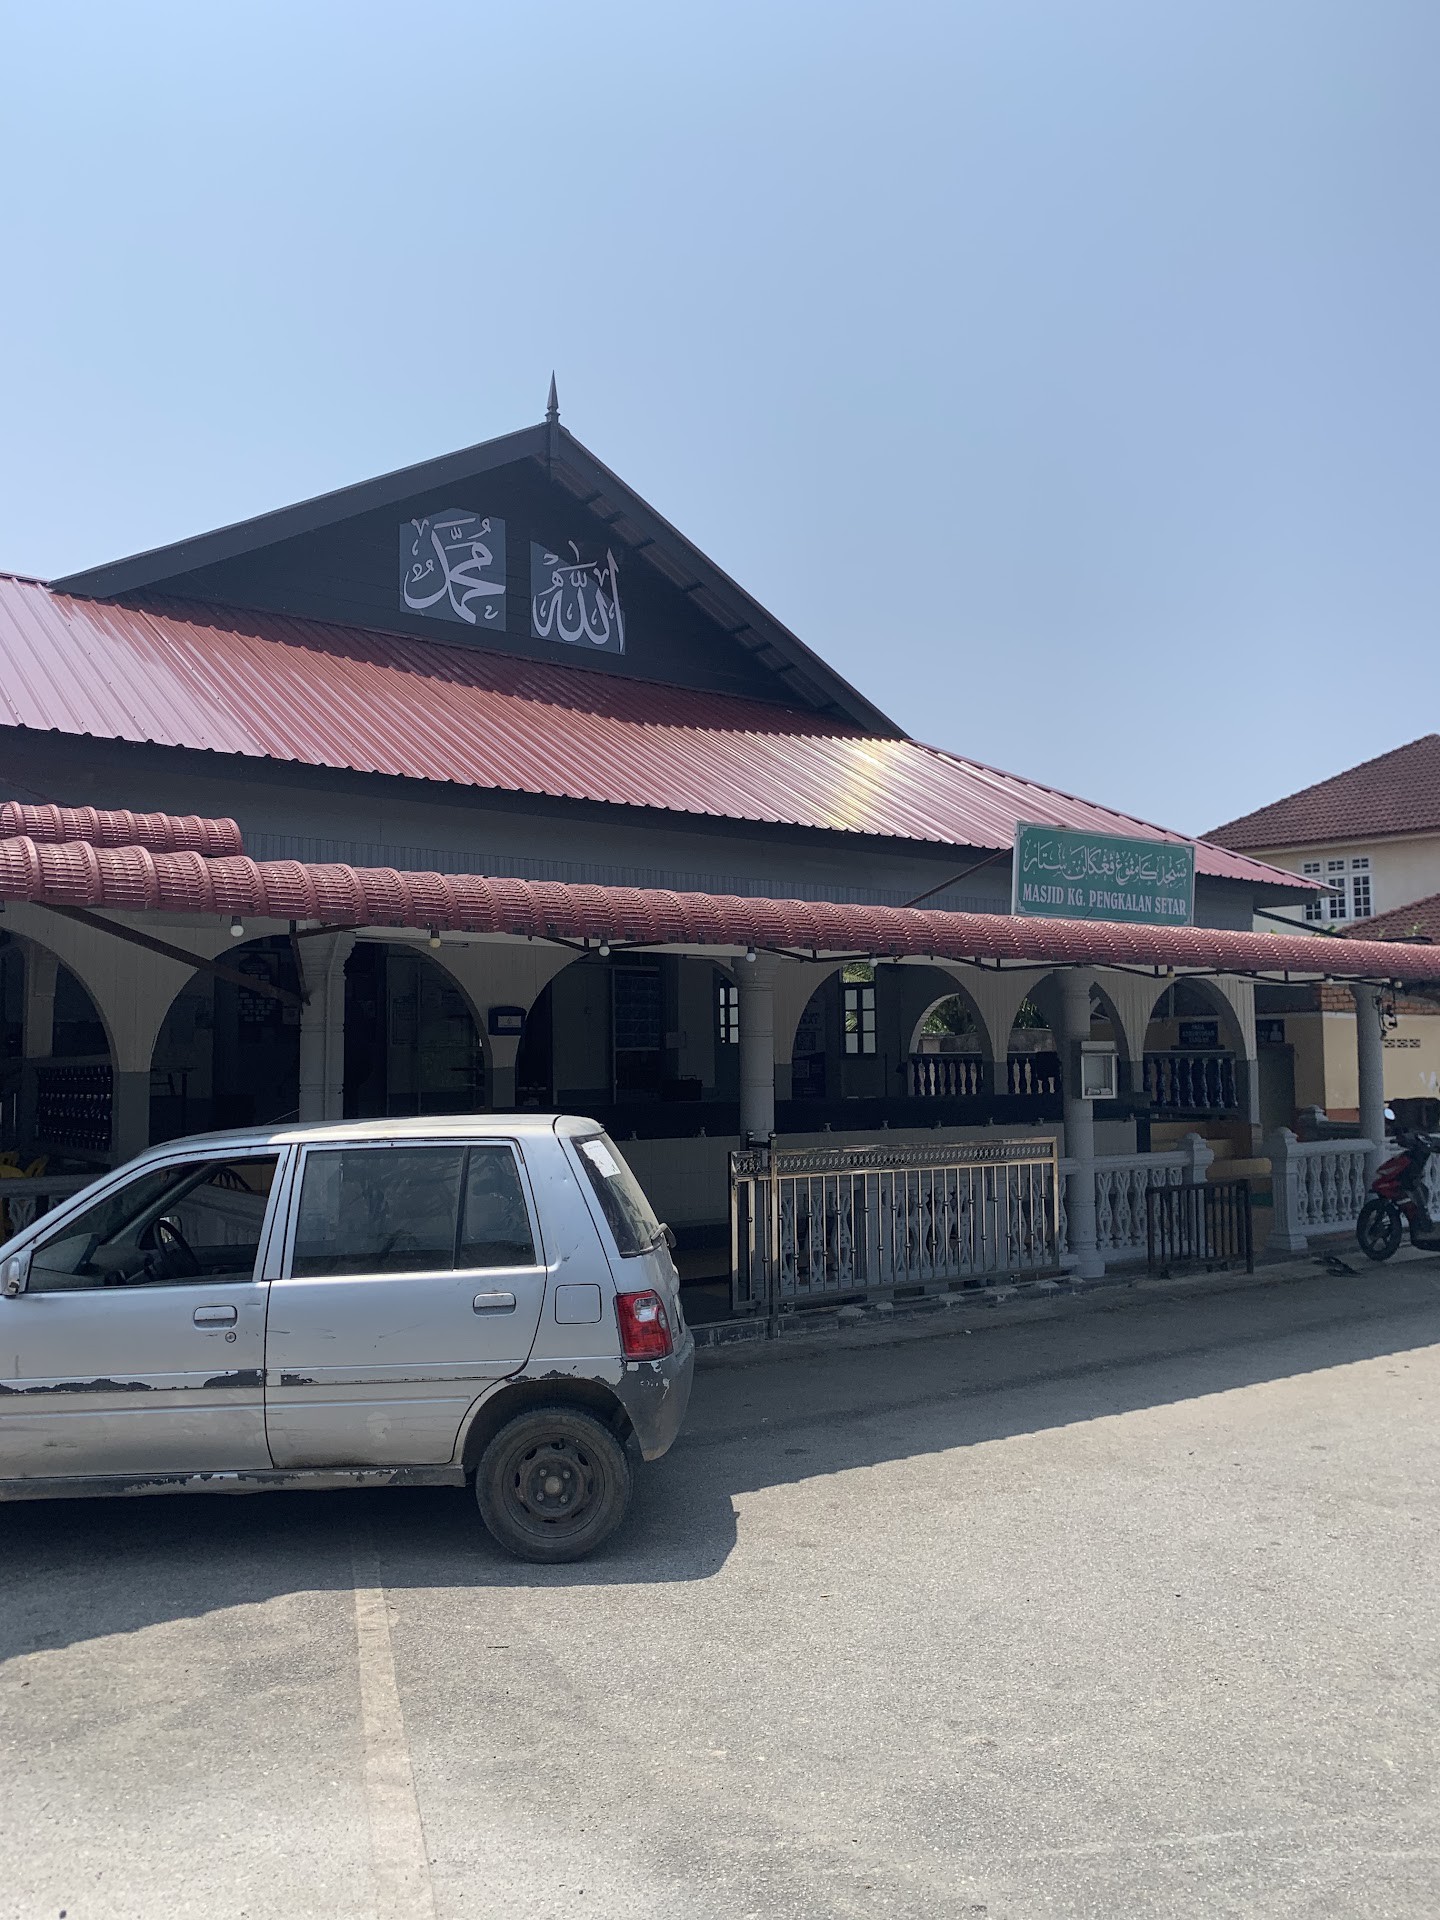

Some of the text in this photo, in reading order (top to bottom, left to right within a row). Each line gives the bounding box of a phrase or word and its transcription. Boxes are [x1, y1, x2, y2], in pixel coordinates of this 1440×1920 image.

[1023, 883, 1187, 916] MASJID KG. PENGKALAN SETAR
